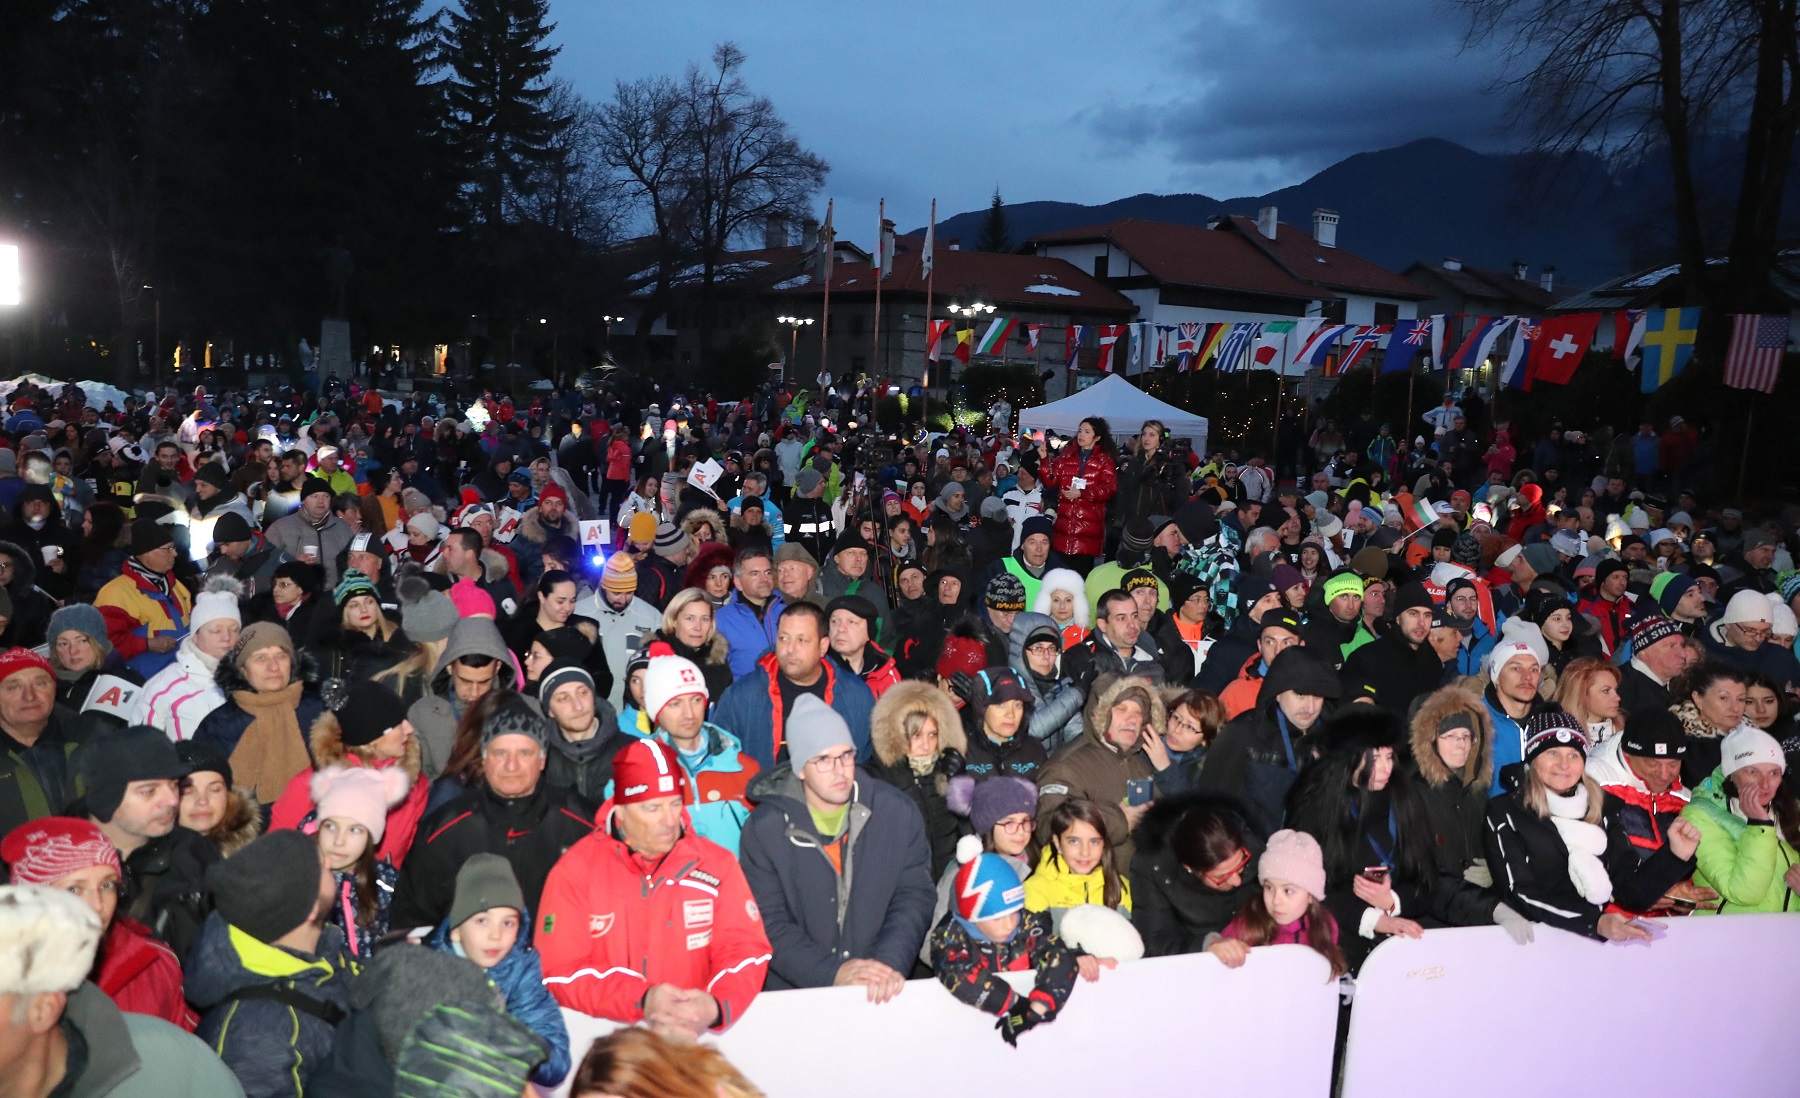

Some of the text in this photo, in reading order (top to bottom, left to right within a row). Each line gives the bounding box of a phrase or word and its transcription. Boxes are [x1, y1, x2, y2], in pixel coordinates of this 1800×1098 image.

[694, 468, 707, 485] A1
[587, 523, 603, 541] A1
[1651, 625, 1672, 640] SKI
[96, 686, 135, 707] A1
